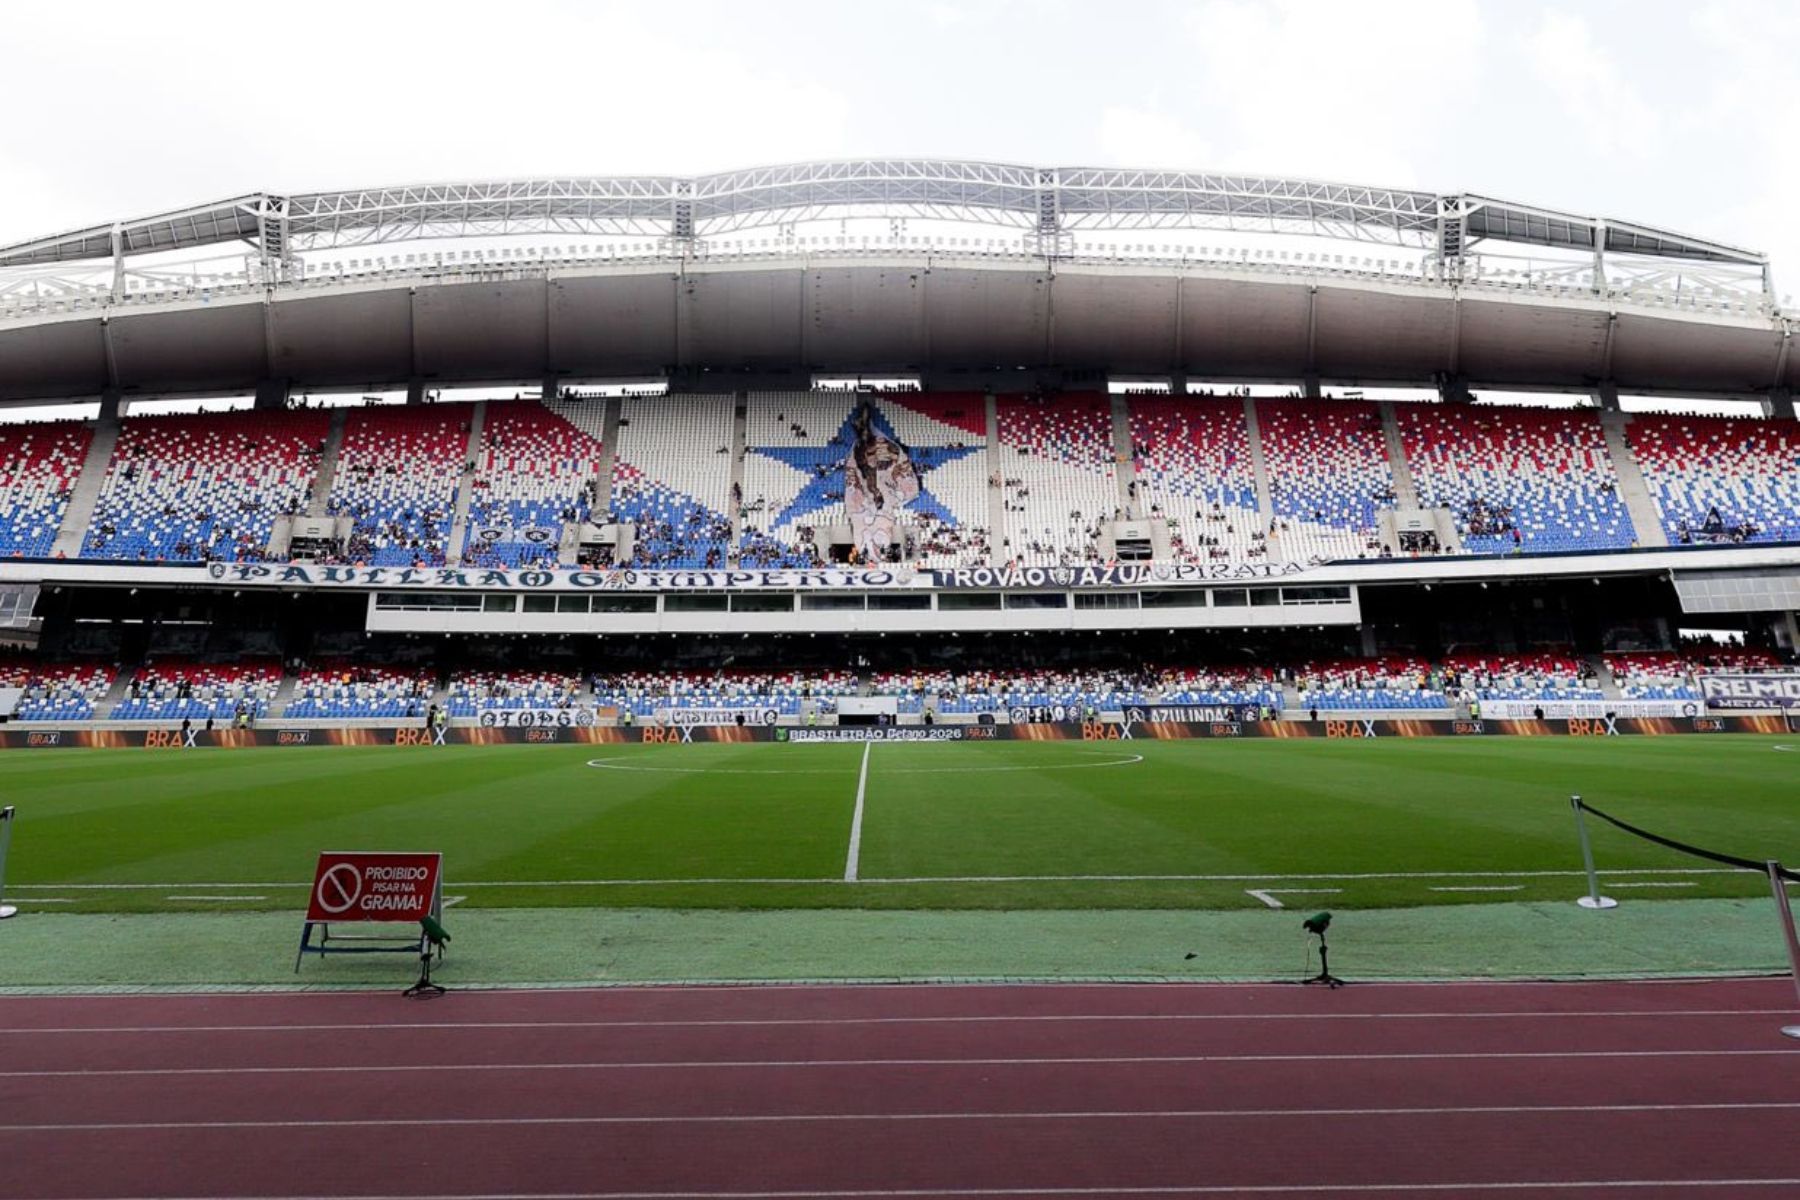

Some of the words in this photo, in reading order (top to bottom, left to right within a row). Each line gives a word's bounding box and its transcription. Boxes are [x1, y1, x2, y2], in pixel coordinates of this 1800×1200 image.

[643, 726, 693, 743] BRAX
[930, 728, 962, 739] 2026
[1083, 722, 1133, 740] BRAX
[1326, 720, 1377, 738] BRAX
[1568, 718, 1619, 736] BRAX
[146, 731, 199, 748] BRAX
[396, 727, 446, 745] BRAX
[365, 867, 428, 880] PROIBIDO
[372, 882, 401, 892] PISAR
[401, 883, 416, 892] NA
[360, 895, 423, 910] GRAMA!
